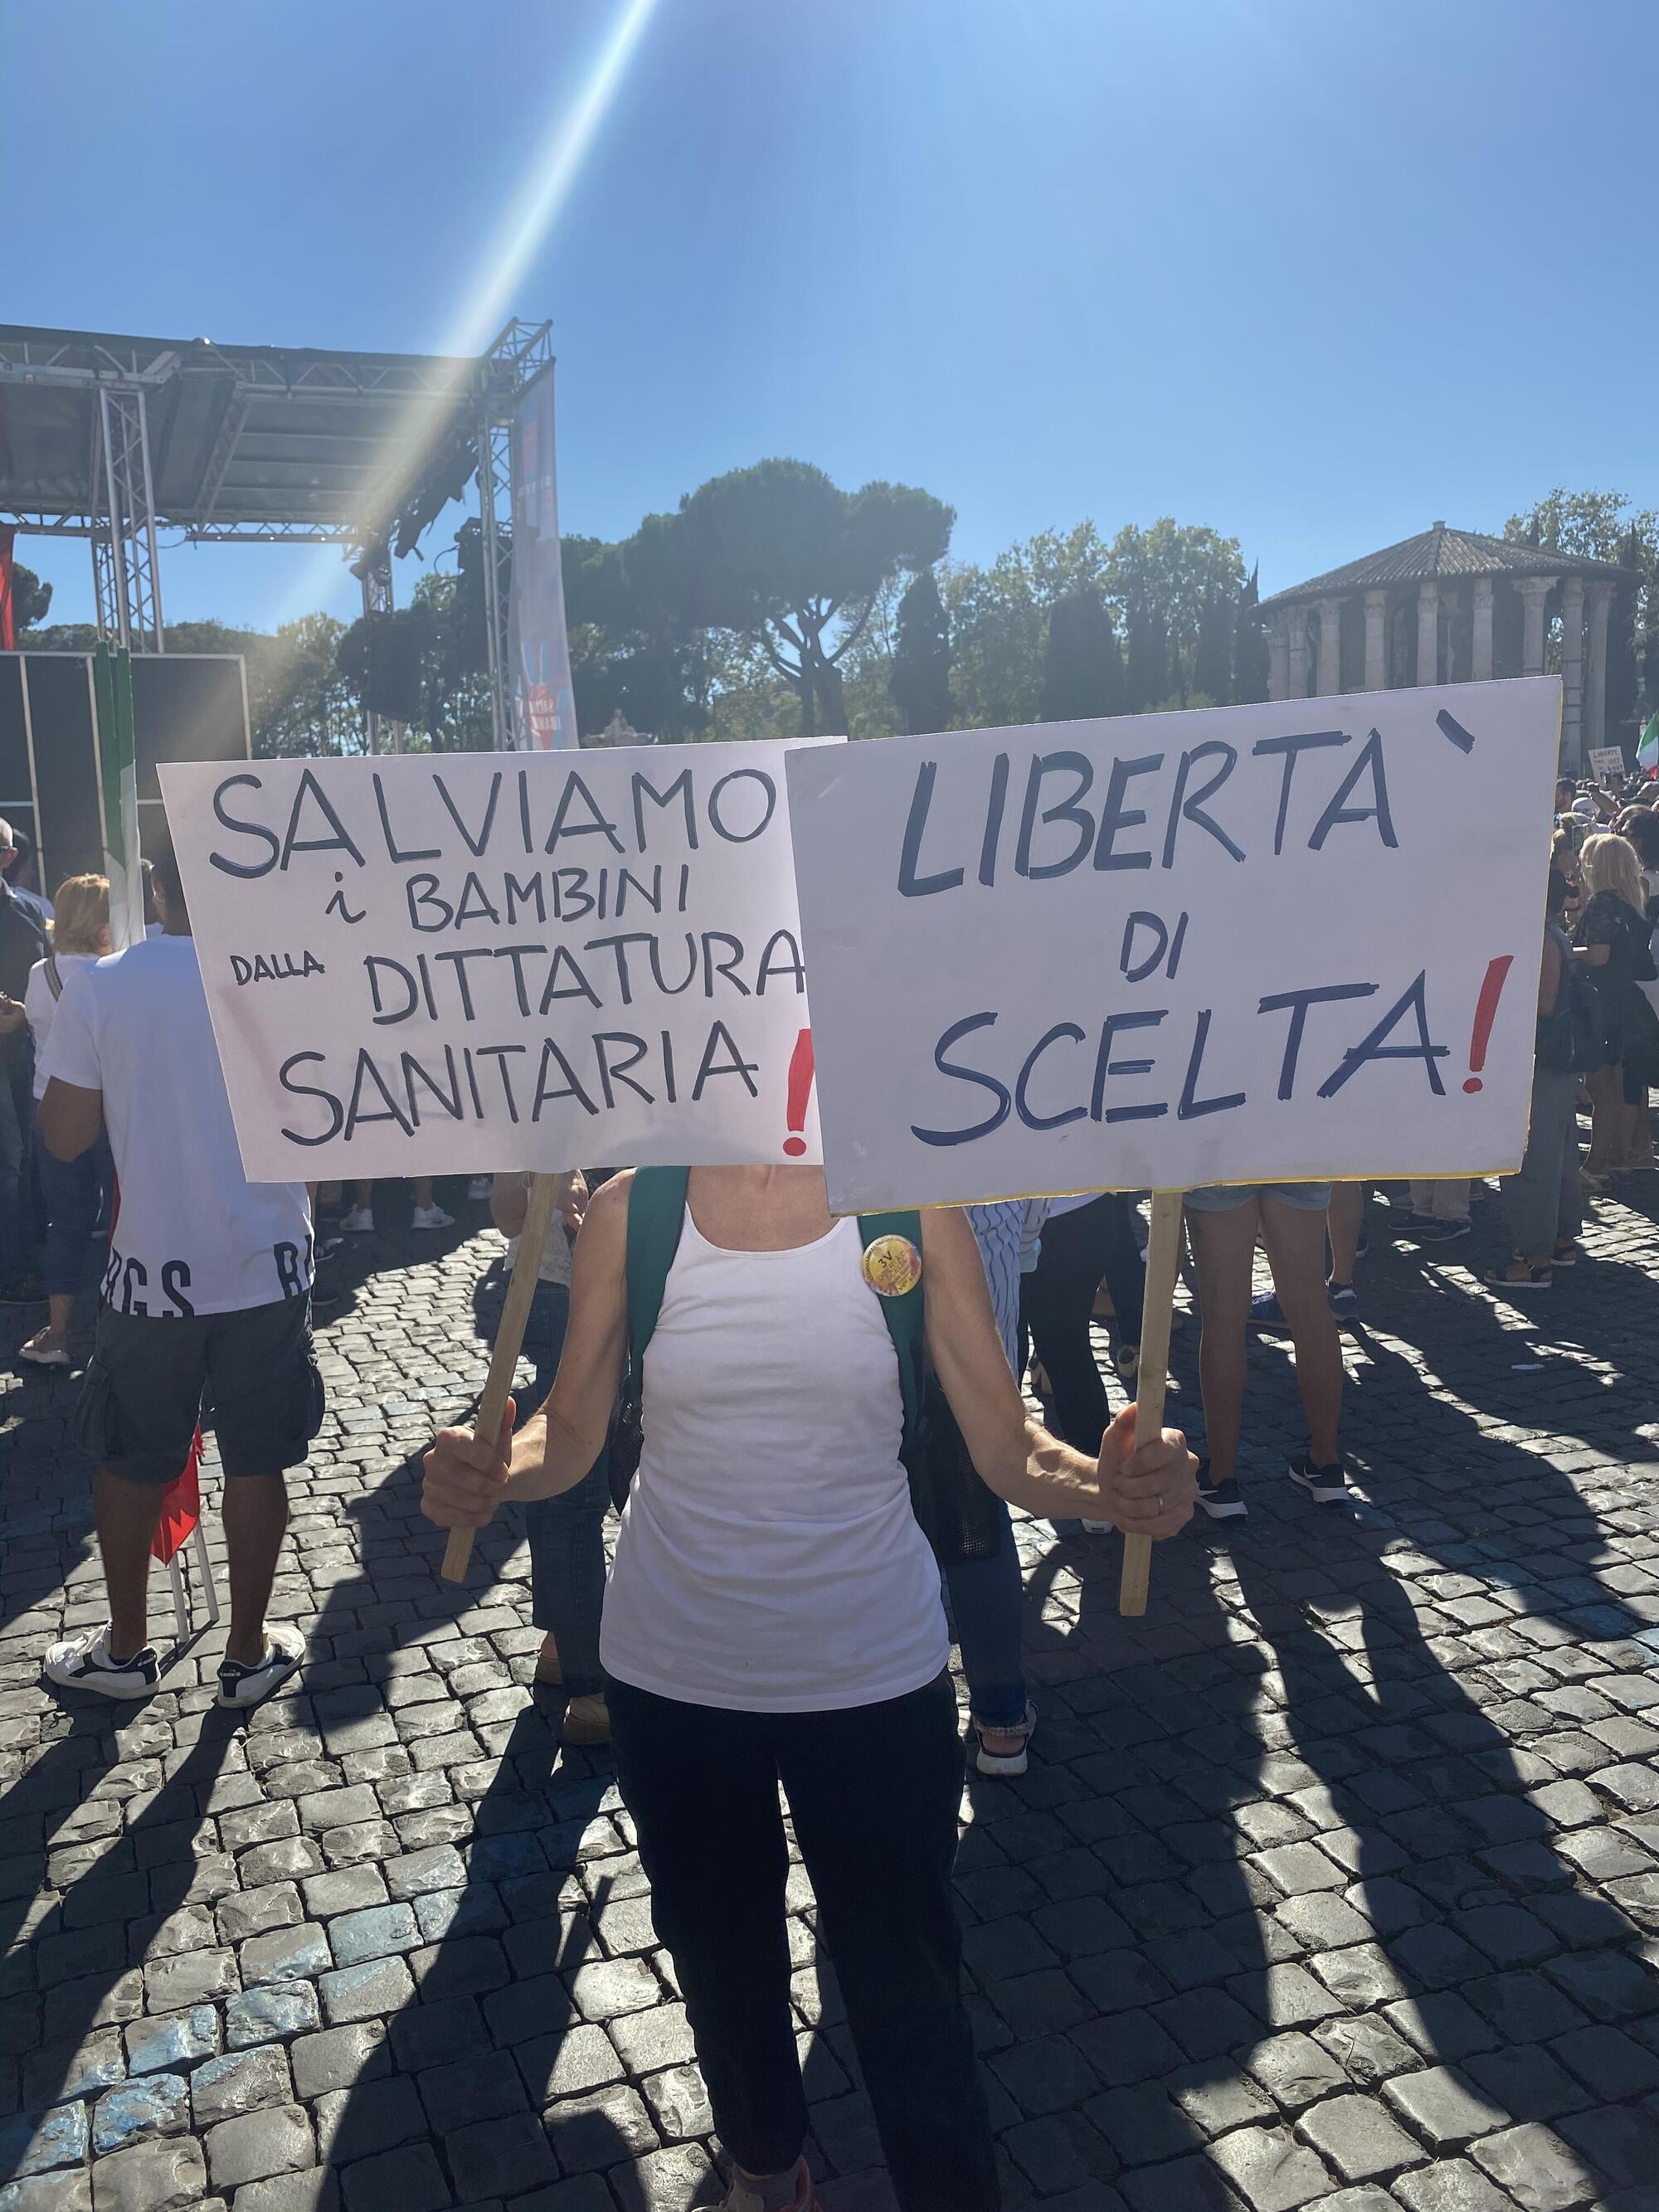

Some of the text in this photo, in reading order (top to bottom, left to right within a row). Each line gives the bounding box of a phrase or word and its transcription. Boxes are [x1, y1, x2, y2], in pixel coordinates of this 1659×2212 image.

[209, 768, 776, 880] SALVIAMO
[324, 863, 689, 933] i BAMBINI
[229, 928, 806, 1025] DALLA DITTATURA
[1119, 911, 1190, 984] DI
